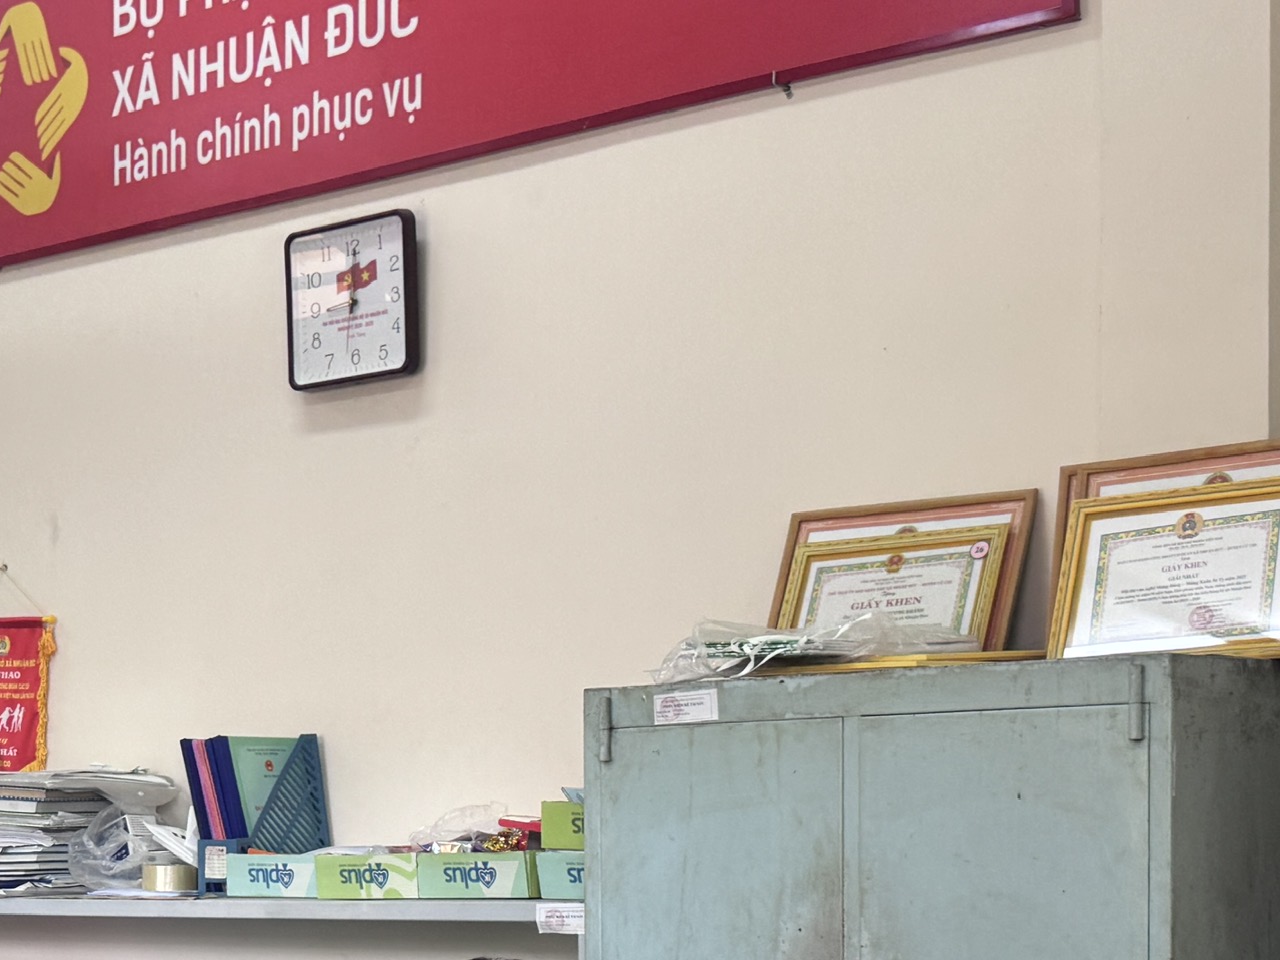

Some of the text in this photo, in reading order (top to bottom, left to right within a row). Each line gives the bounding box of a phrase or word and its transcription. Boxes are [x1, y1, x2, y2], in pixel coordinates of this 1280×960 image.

[111, 50, 161, 118] XÃ
[171, 14, 311, 101] NHUẬN
[112, 72, 423, 187] Hành chính phục vụ
[345, 239, 360, 258] 12
[377, 234, 383, 250] 1
[389, 255, 400, 272] 2
[306, 272, 322, 290] 10
[390, 286, 401, 303] 3
[310, 302, 321, 319] 9
[391, 317, 401, 334] 4
[311, 332, 322, 350] 8
[350, 349, 361, 366] 6
[378, 344, 389, 361] 5
[324, 353, 335, 370] 7
[850, 597, 882, 611] GIẤY
[885, 596, 922, 608] KHEN
[248, 863, 280, 889] plus
[340, 863, 373, 889] plus
[443, 861, 480, 889] plus
